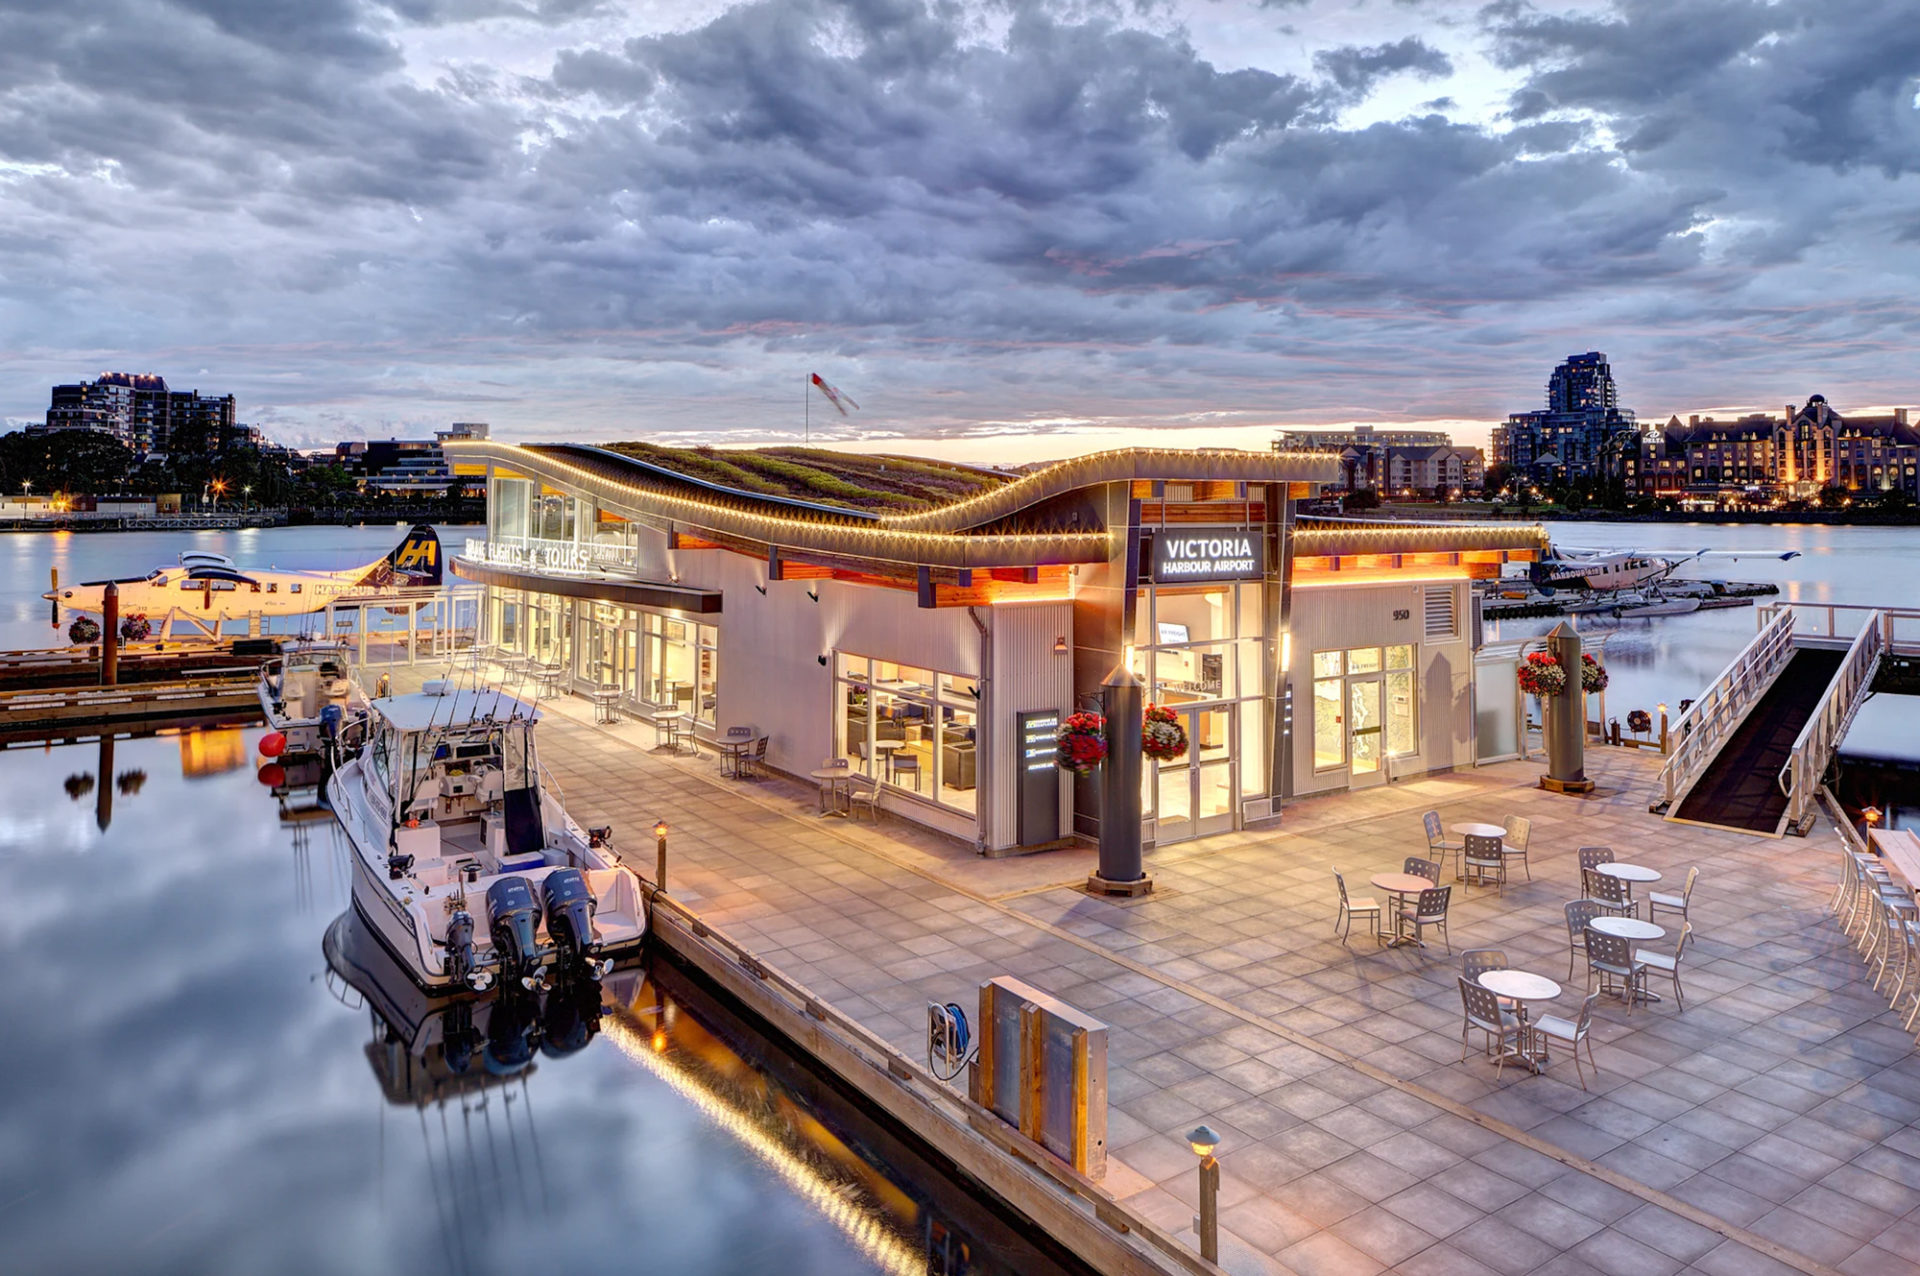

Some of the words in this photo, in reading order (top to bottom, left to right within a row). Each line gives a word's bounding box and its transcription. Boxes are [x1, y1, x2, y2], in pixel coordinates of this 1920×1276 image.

[488, 541, 522, 563] FLIGHTS
[545, 546, 589, 569] TOURS
[1166, 538, 1252, 559] VICTORIA
[1162, 560, 1212, 574] HARBOUR
[1213, 559, 1255, 573] AIRPORT
[1551, 568, 1585, 580] HARBOUR
[315, 584, 376, 596] HARBOUR
[378, 584, 399, 596] AIR
[1393, 609, 1410, 621] 950
[1174, 680, 1222, 693] WELCOME
